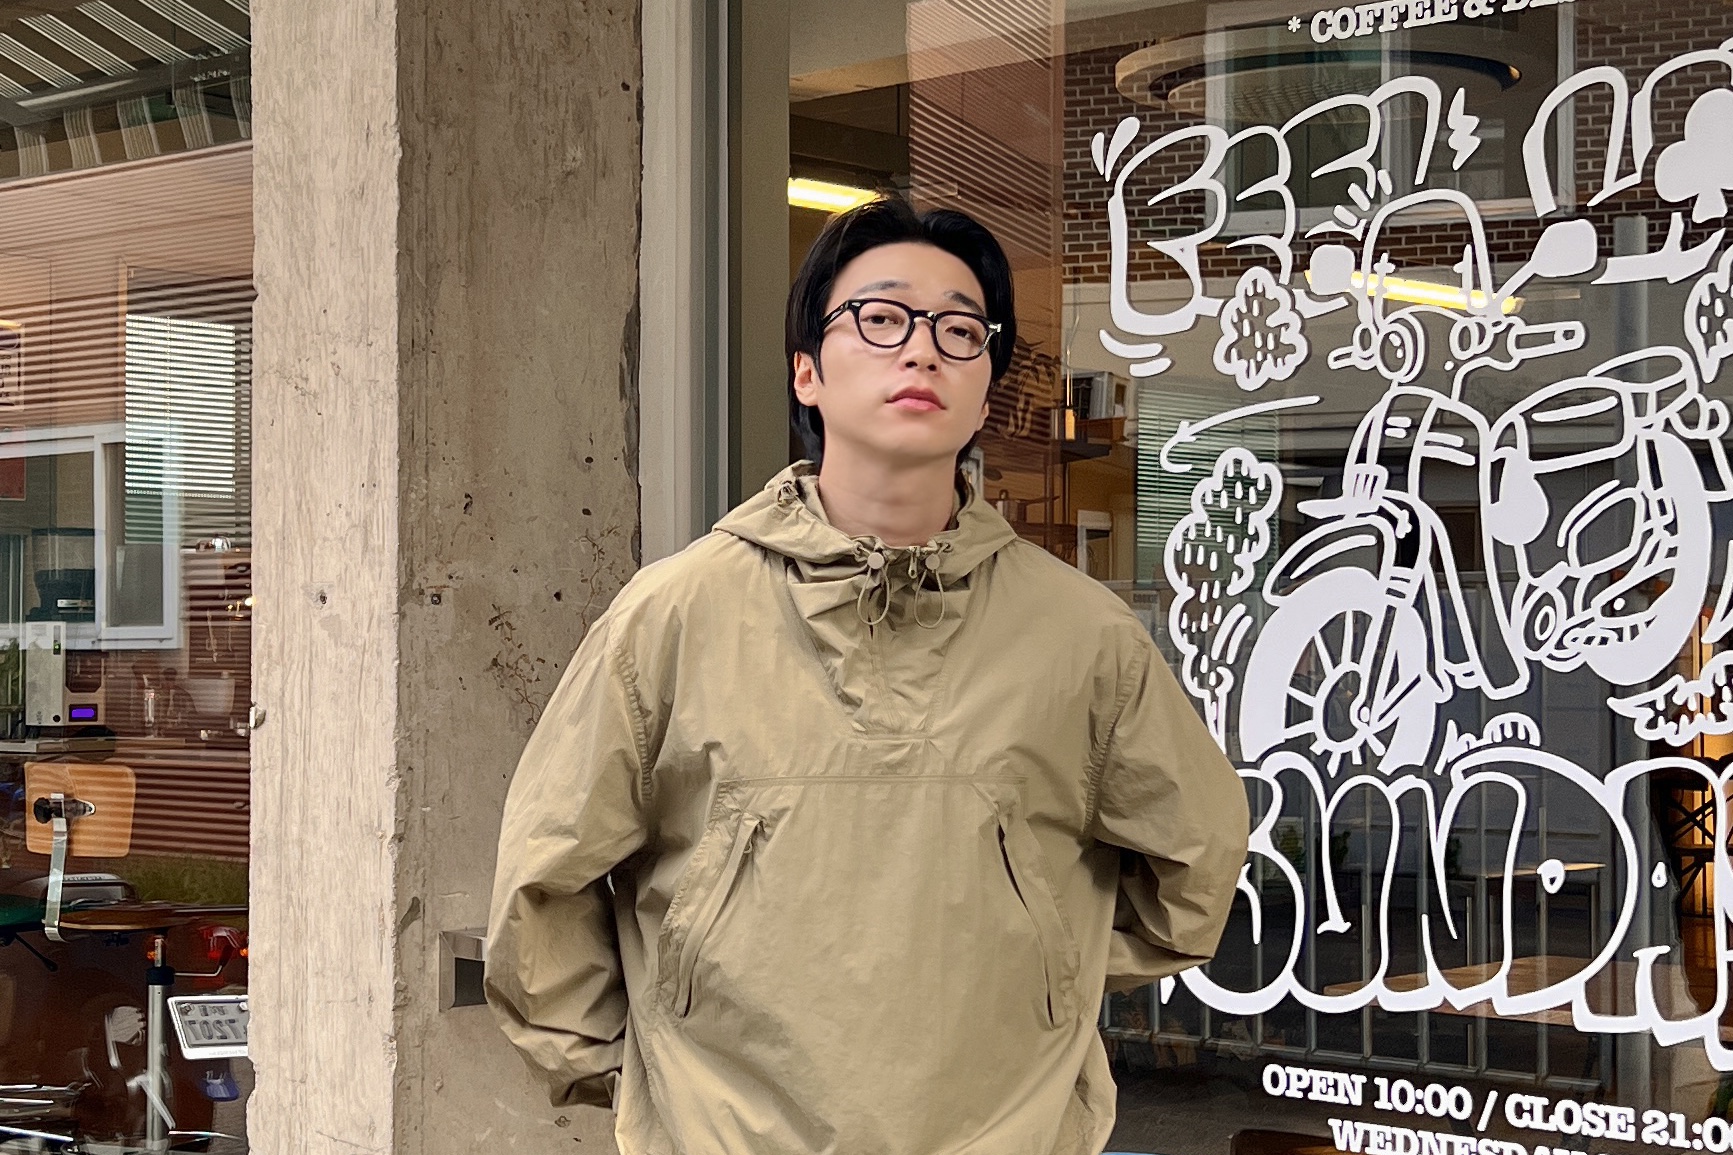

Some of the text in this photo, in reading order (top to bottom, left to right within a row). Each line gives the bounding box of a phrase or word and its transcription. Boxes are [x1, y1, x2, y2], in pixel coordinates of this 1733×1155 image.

[1310, 0, 1458, 43] COFFEE
[1262, 1063, 1733, 1153] OPEN 10:00 / CLOSE 21:0
